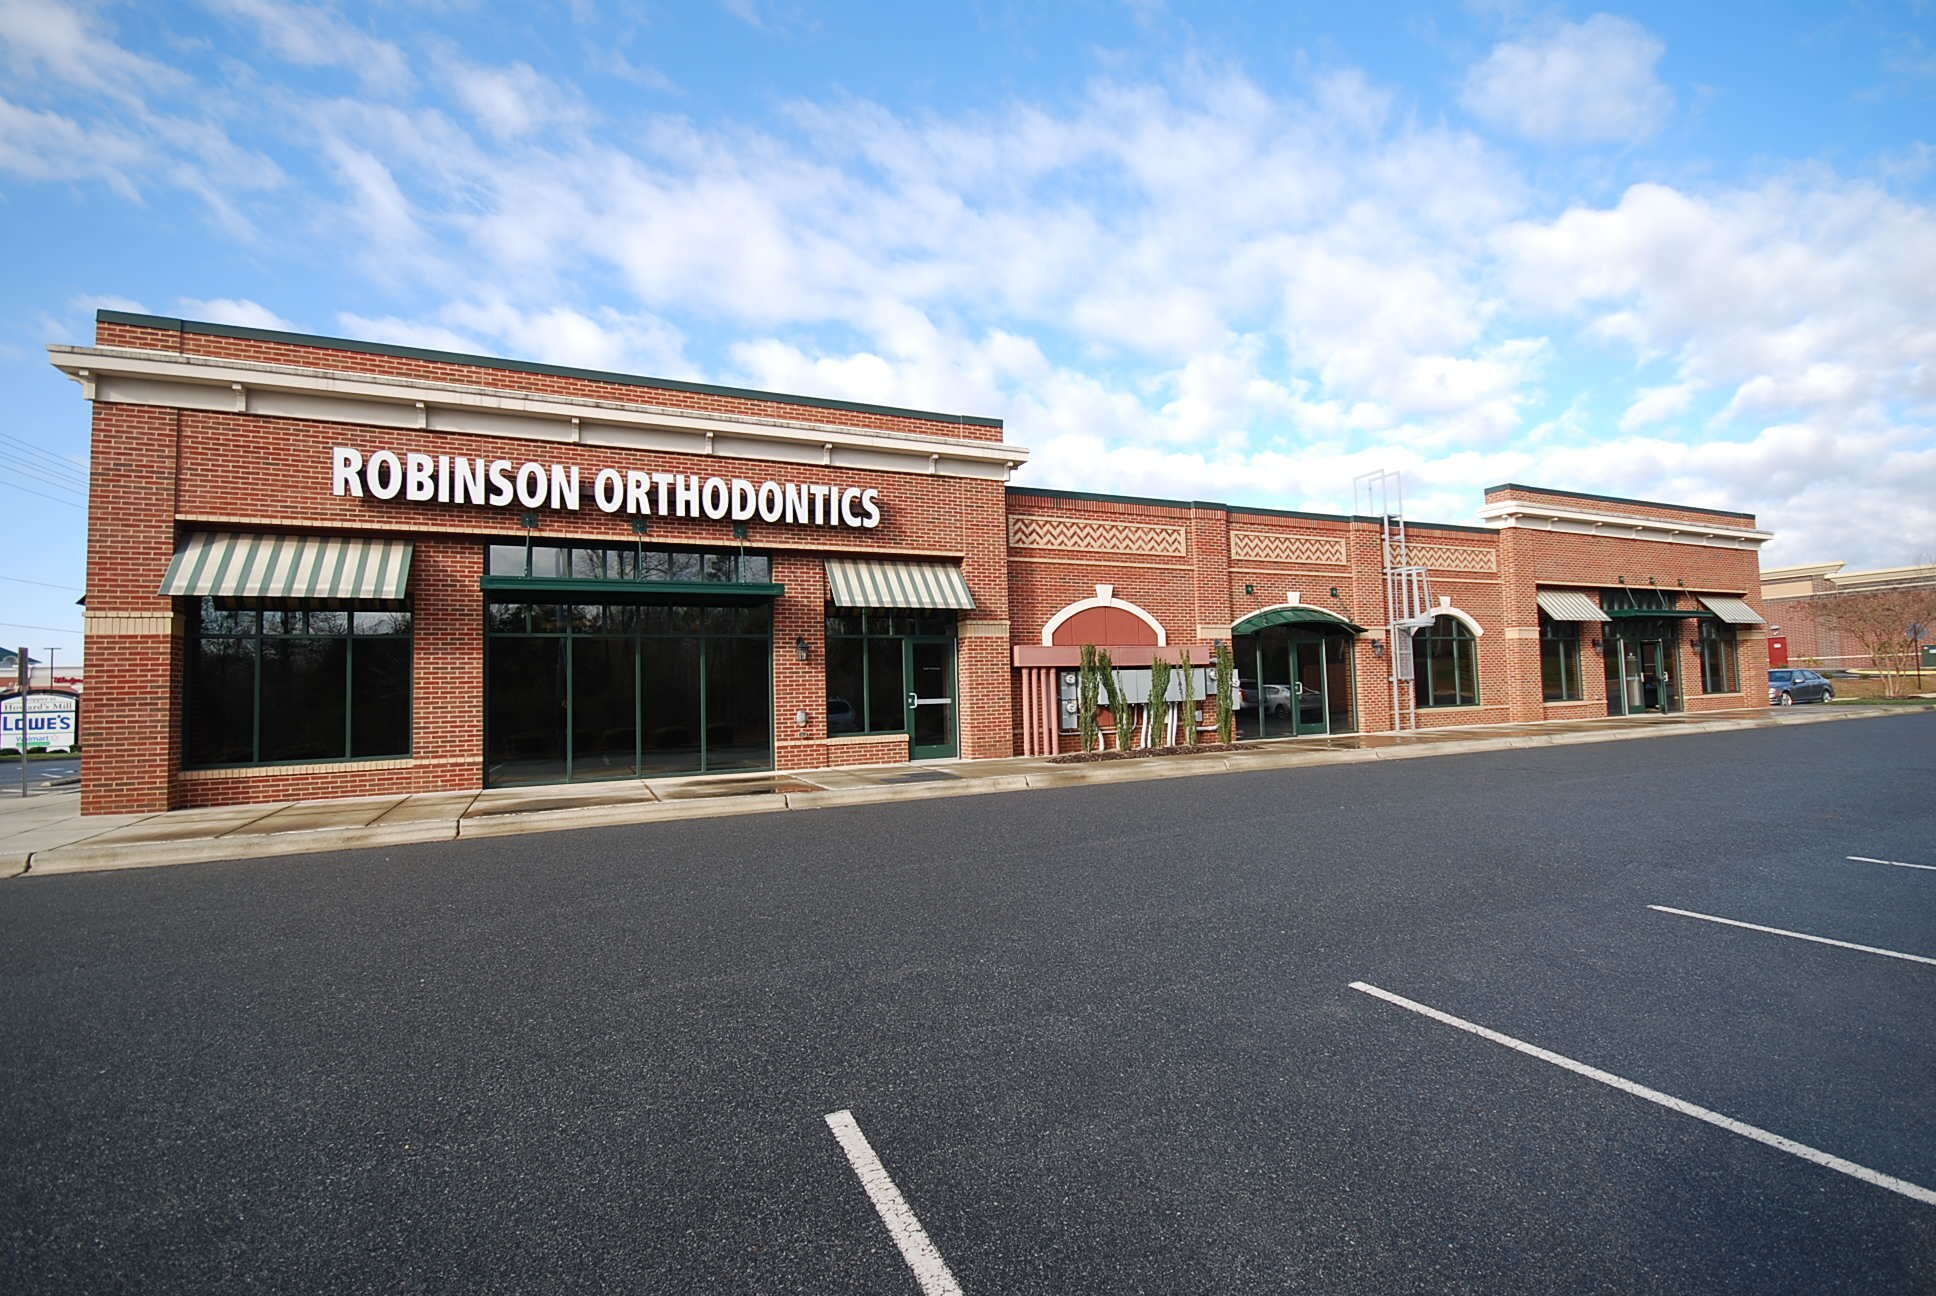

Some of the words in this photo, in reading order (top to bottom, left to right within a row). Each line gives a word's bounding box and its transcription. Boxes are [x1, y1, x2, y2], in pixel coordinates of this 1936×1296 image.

[332, 446, 580, 511] ROBINSON
[594, 468, 881, 528] ORTHODONTICS
[5, 703, 49, 711] Hoard's
[53, 701, 72, 709] Mill
[3, 715, 71, 731] LOWE'S
